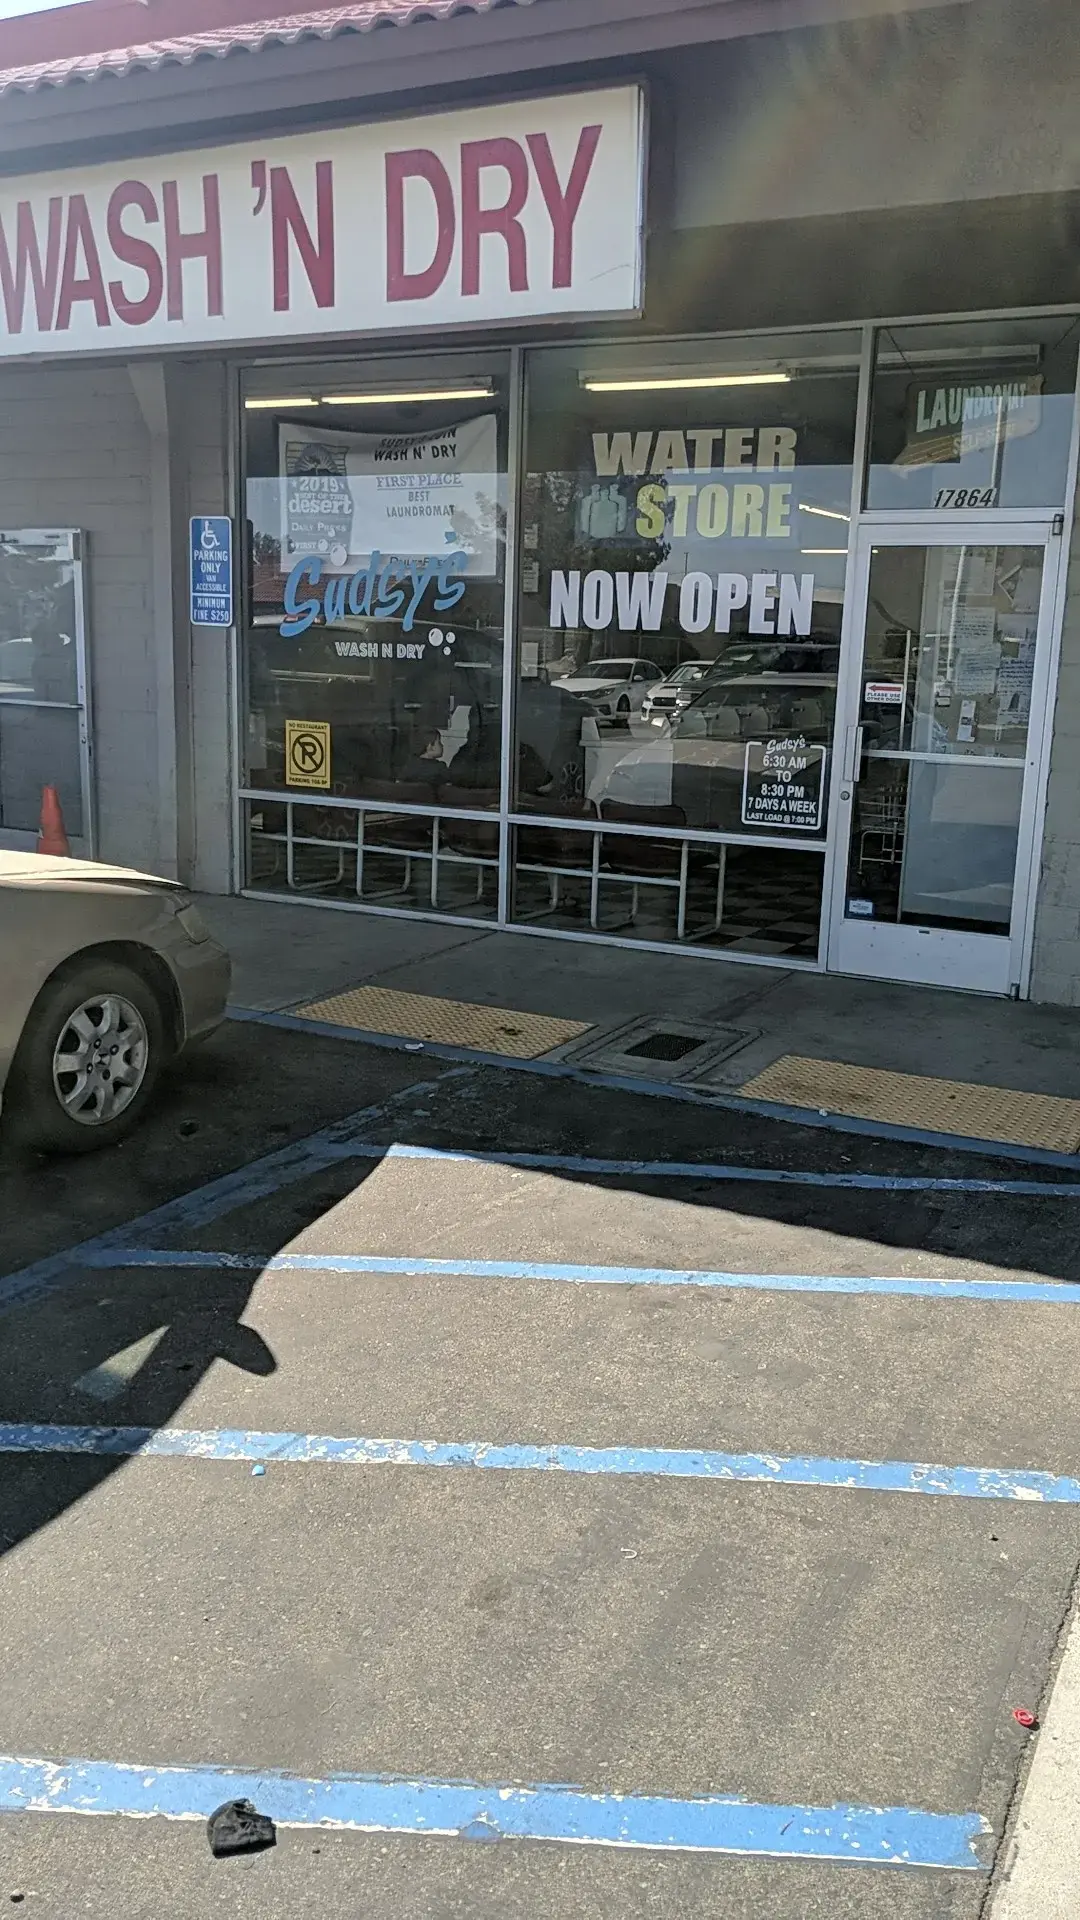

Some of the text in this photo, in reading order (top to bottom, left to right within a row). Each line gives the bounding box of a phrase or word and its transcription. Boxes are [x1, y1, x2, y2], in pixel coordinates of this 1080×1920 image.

[0, 124, 603, 334] WASH 'N DRY
[916, 383, 1027, 433] LAUNDROMAT
[374, 444, 457, 461] WASH N' DRY
[592, 427, 798, 477] WATER
[299, 476, 339, 493] 2019
[376, 472, 462, 488] FIRST PLACE
[288, 493, 353, 515] desert
[408, 490, 430, 502] BEST
[934, 488, 994, 508] 17864
[386, 504, 455, 518] LAUNDROMAT
[635, 483, 792, 539] STORE
[193, 550, 229, 562] PARKING
[200, 562, 221, 574] ONLY
[206, 574, 217, 583] VAN
[195, 583, 227, 592] ACCESSIBLE
[197, 597, 226, 609] MINIMUM
[550, 569, 815, 636] NOW OPEN
[193, 609, 229, 622] FINE $250
[334, 641, 426, 659] WASH N DRY
[766, 734, 807, 755] Sudsy's
[762, 755, 807, 769] 6:30 AM
[776, 770, 792, 782] TO
[760, 783, 805, 798] 8:30 PM
[748, 797, 817, 813] 7 DAYS A WEEK
[746, 812, 763, 820] LAST
[764, 813, 782, 822] LOAD
[791, 815, 805, 824] 7:00
[805, 816, 817, 825] PM
